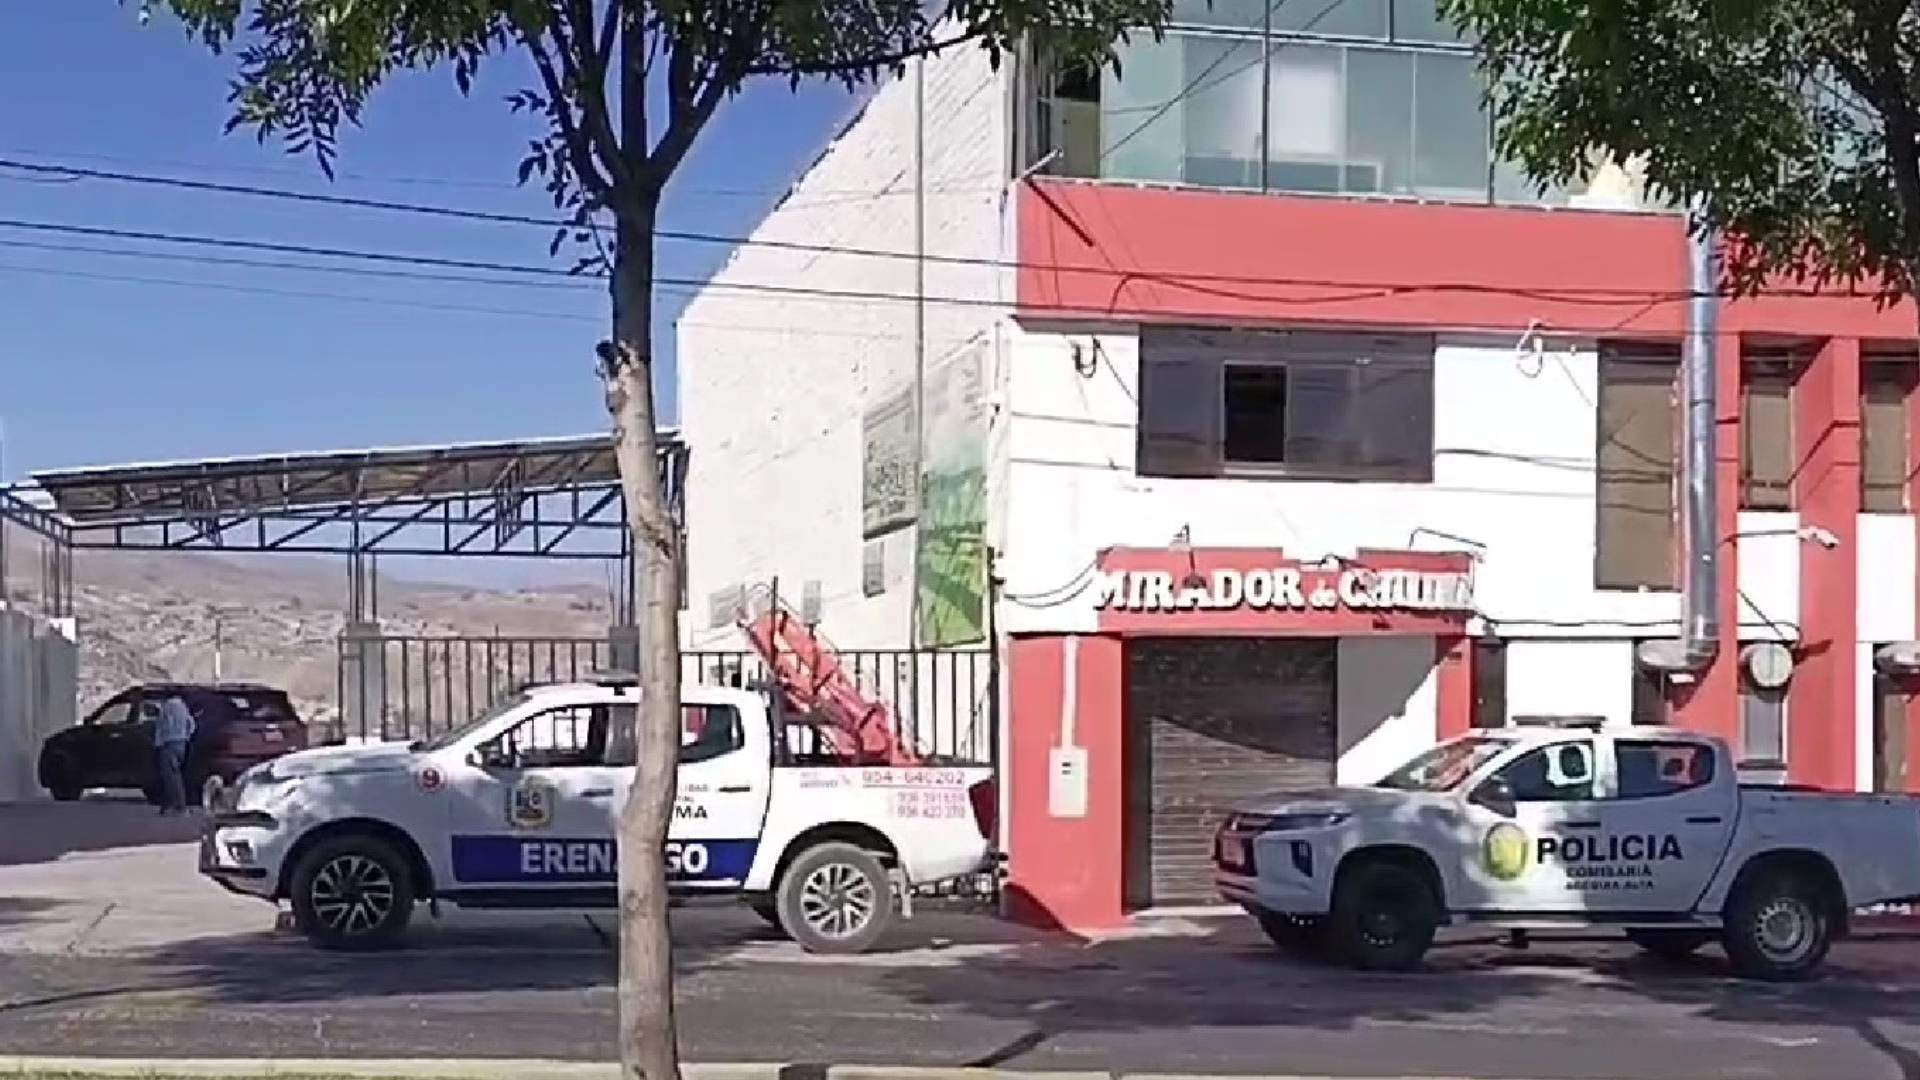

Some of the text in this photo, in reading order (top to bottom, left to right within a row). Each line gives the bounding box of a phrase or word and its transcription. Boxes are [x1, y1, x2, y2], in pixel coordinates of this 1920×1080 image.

[1094, 568, 1302, 608] MIRADOR
[422, 768, 441, 788] 9
[519, 842, 709, 875] ERENGO
[1536, 833, 1684, 864] POLICIA
